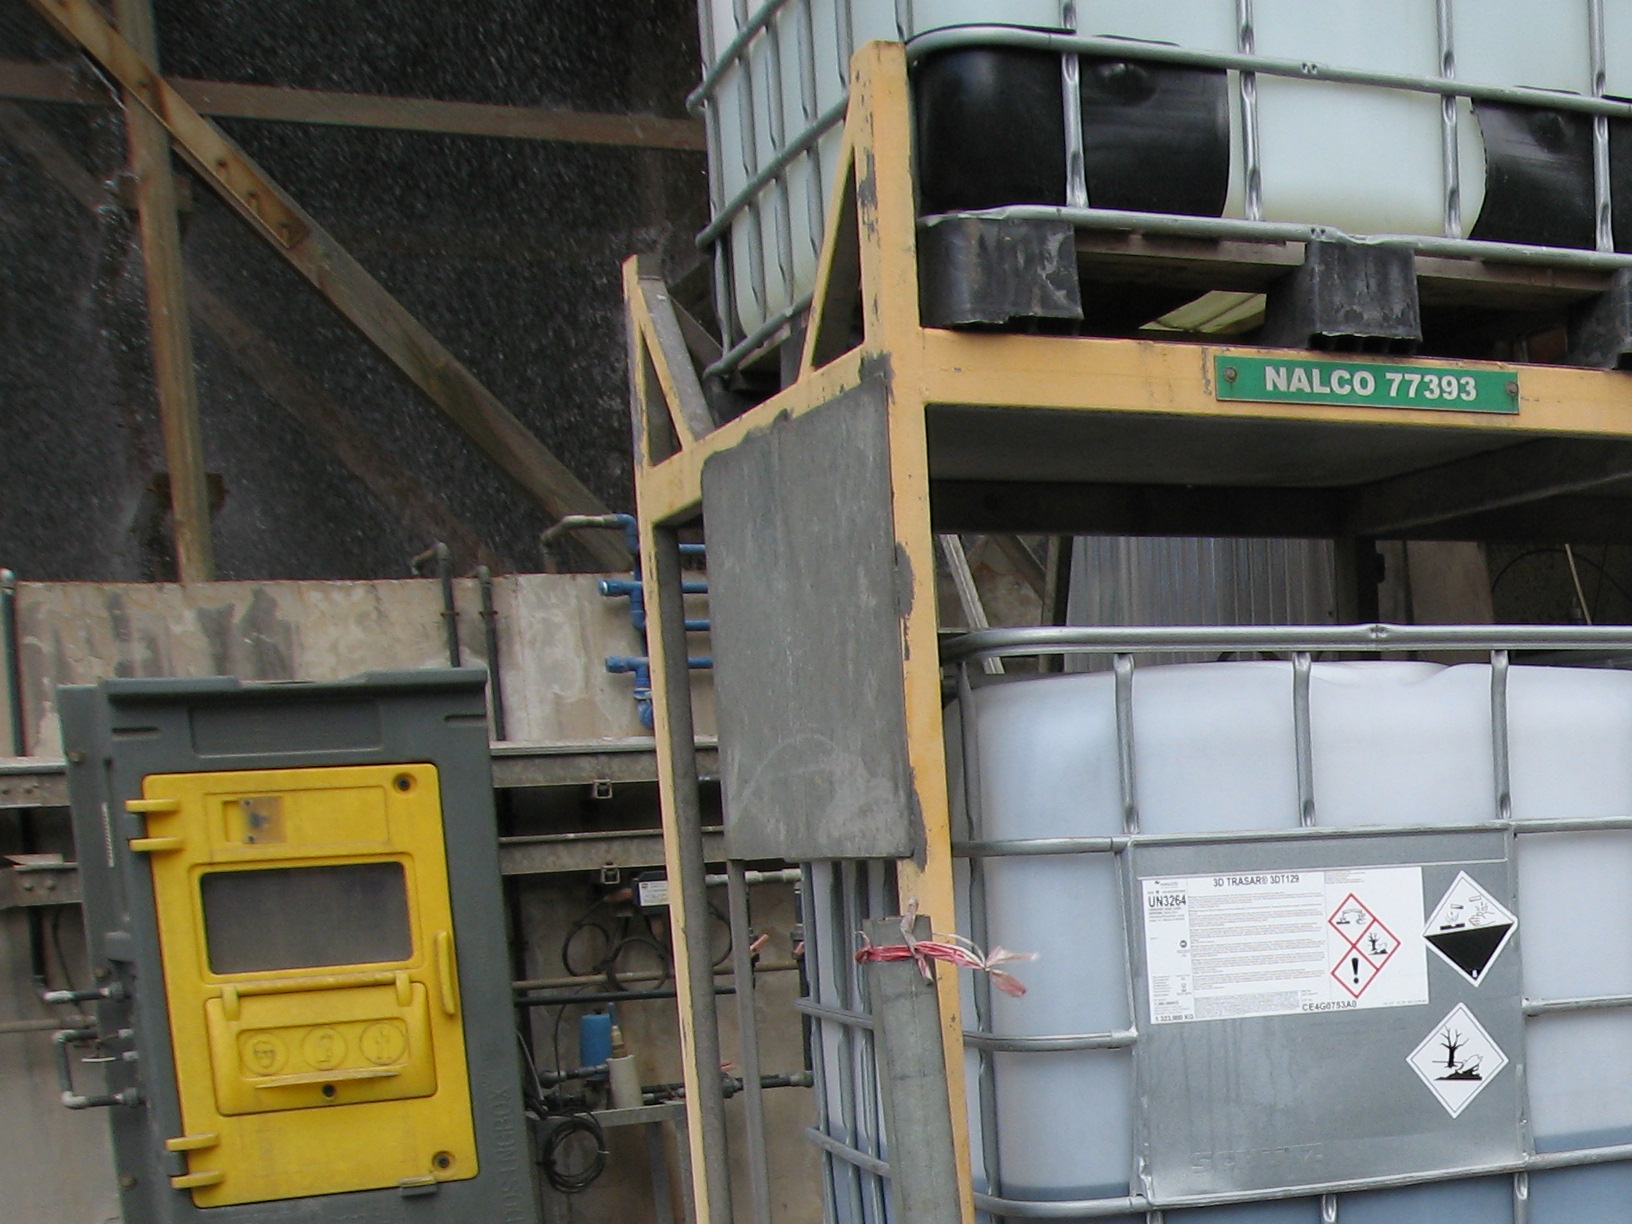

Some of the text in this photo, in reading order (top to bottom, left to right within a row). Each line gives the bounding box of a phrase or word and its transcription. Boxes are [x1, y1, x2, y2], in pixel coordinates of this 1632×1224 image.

[1264, 365, 1477, 402] NALCO 77393
[1213, 878, 1225, 888] 3D
[1269, 874, 1300, 885] 3DT129
[1147, 894, 1187, 908] UN3264
